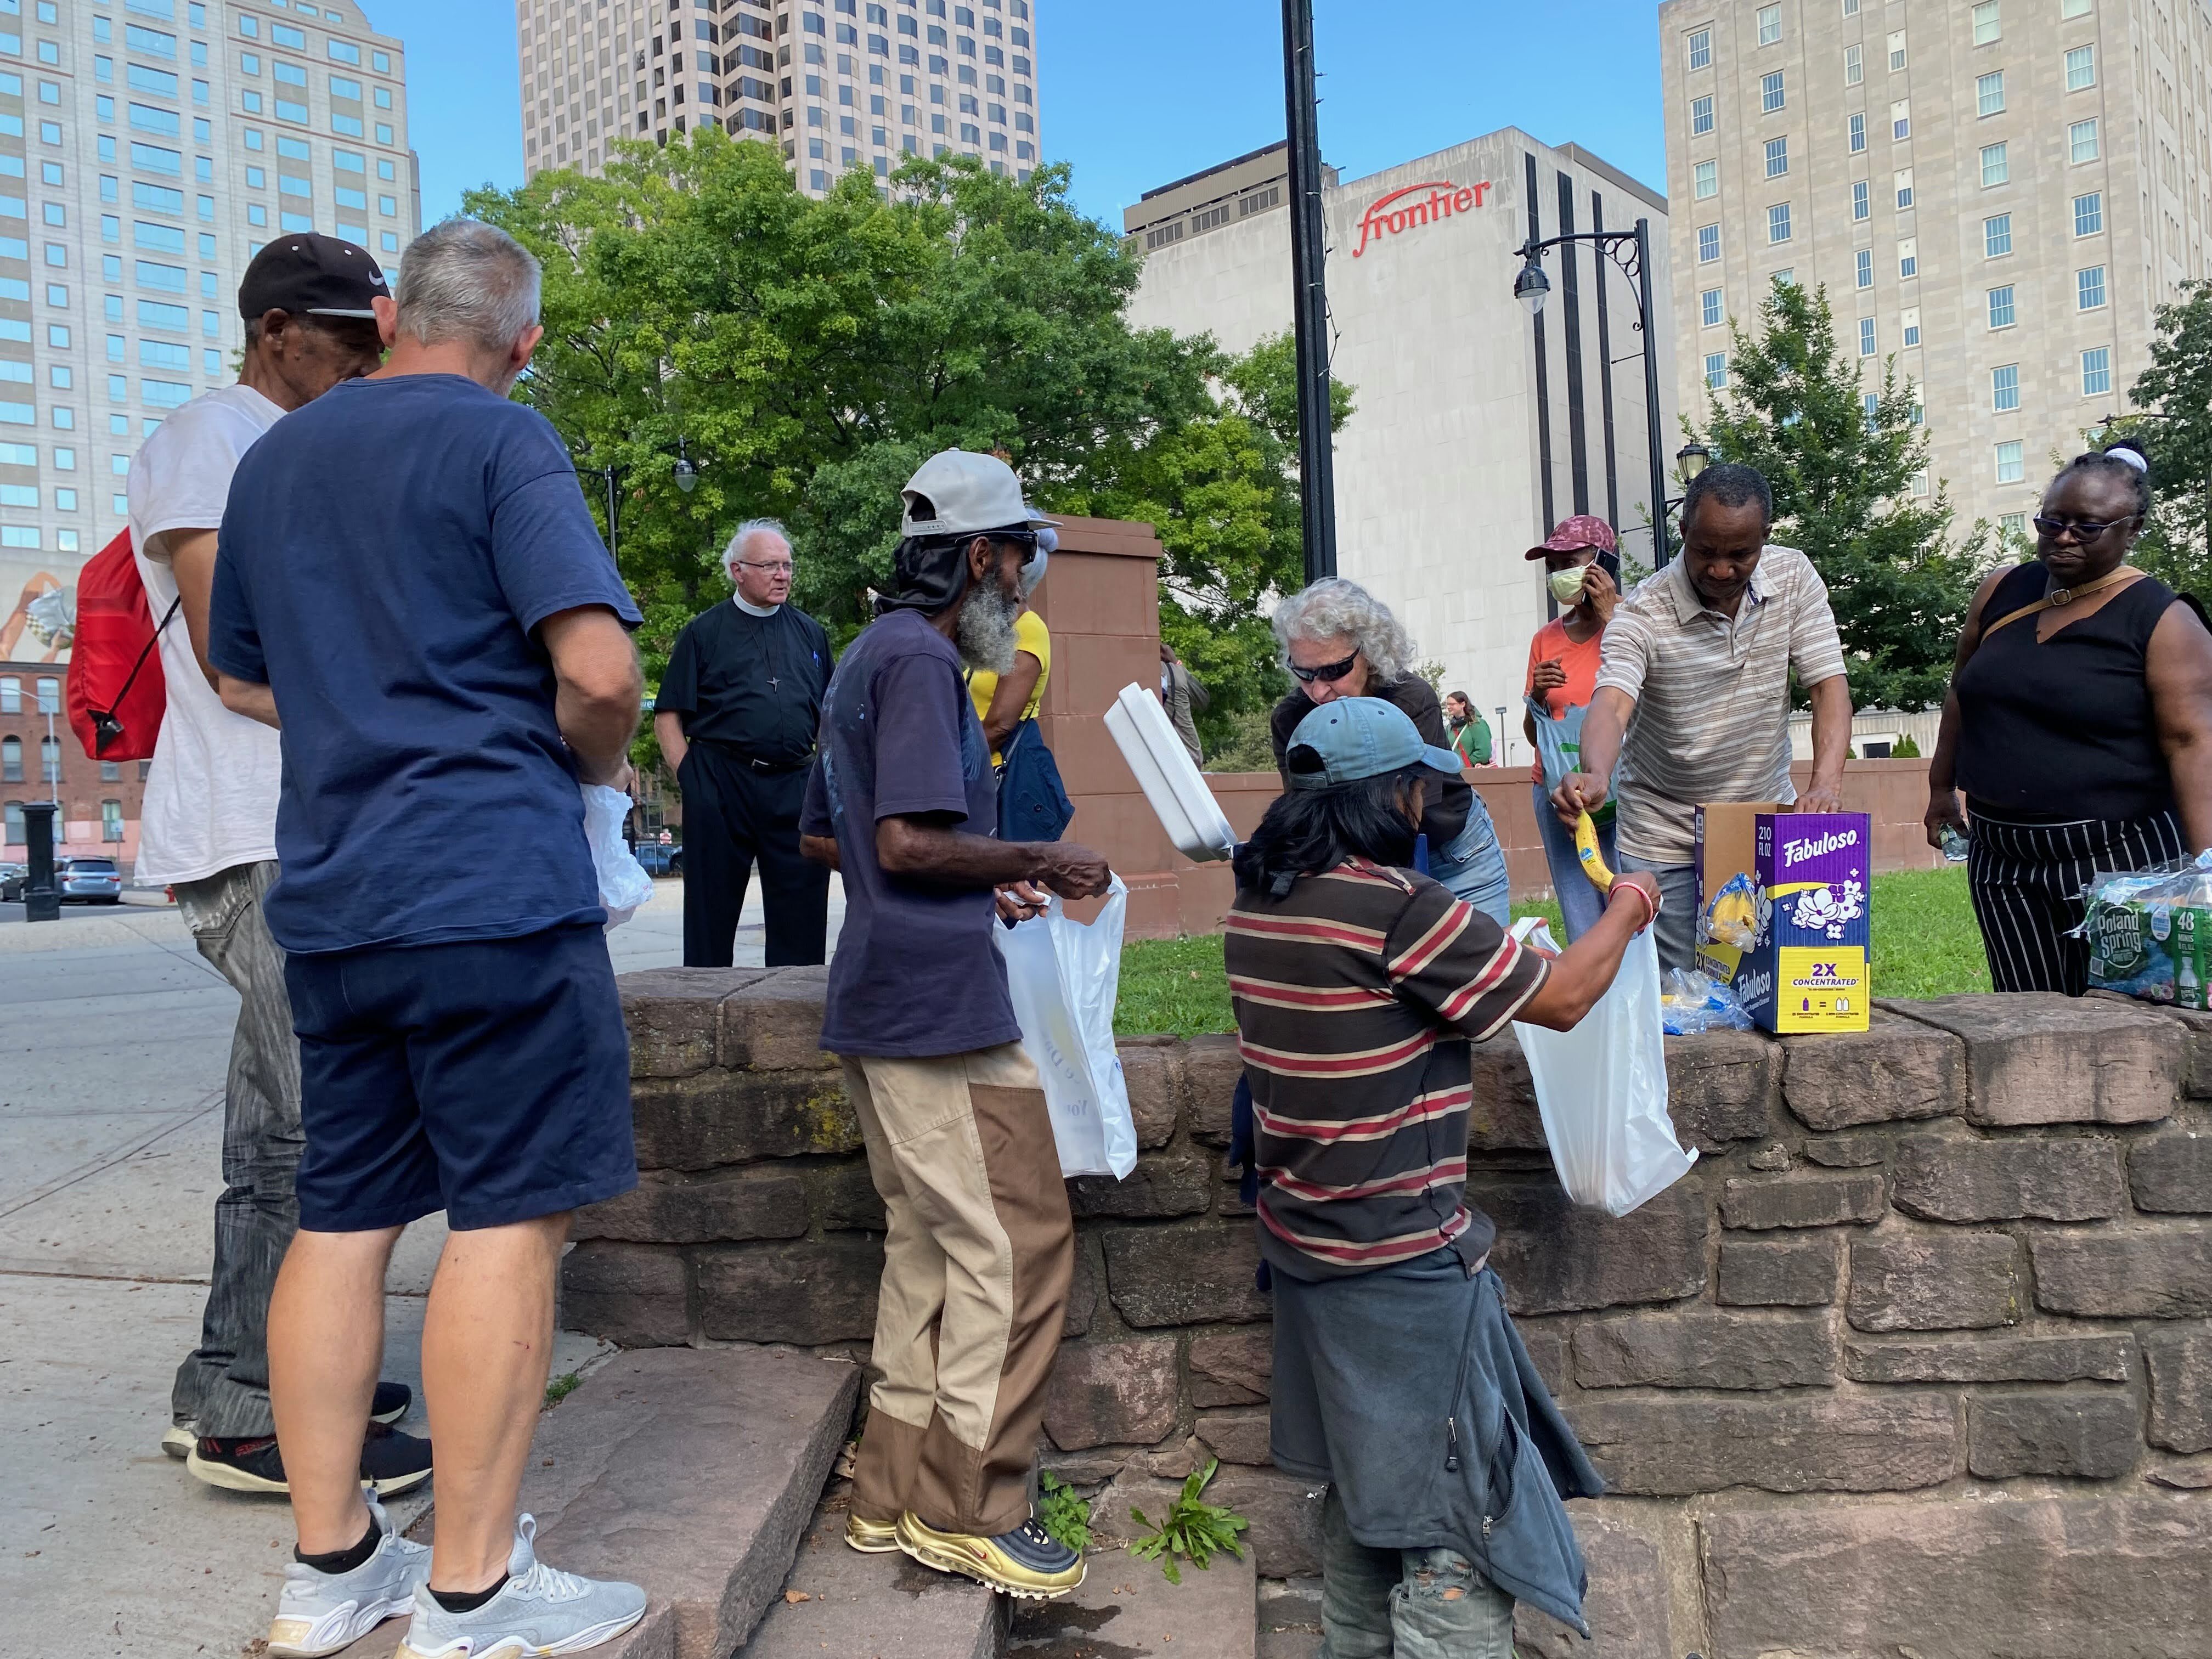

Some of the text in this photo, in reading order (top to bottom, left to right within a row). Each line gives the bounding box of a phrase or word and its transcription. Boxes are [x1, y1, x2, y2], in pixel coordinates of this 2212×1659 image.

[1352, 180, 1491, 257] frontier
[1758, 826, 1771, 840] 210
[1758, 842, 1771, 856] FL OZ
[1784, 830, 1857, 867] Fabuloso
[2098, 909, 2140, 937] Poland
[2177, 911, 2194, 931] 48
[2101, 930, 2142, 958] Spring
[1696, 951, 1705, 973] 2X
[1812, 963, 1837, 977] 2X
[1737, 968, 1770, 1003] Fabuloso
